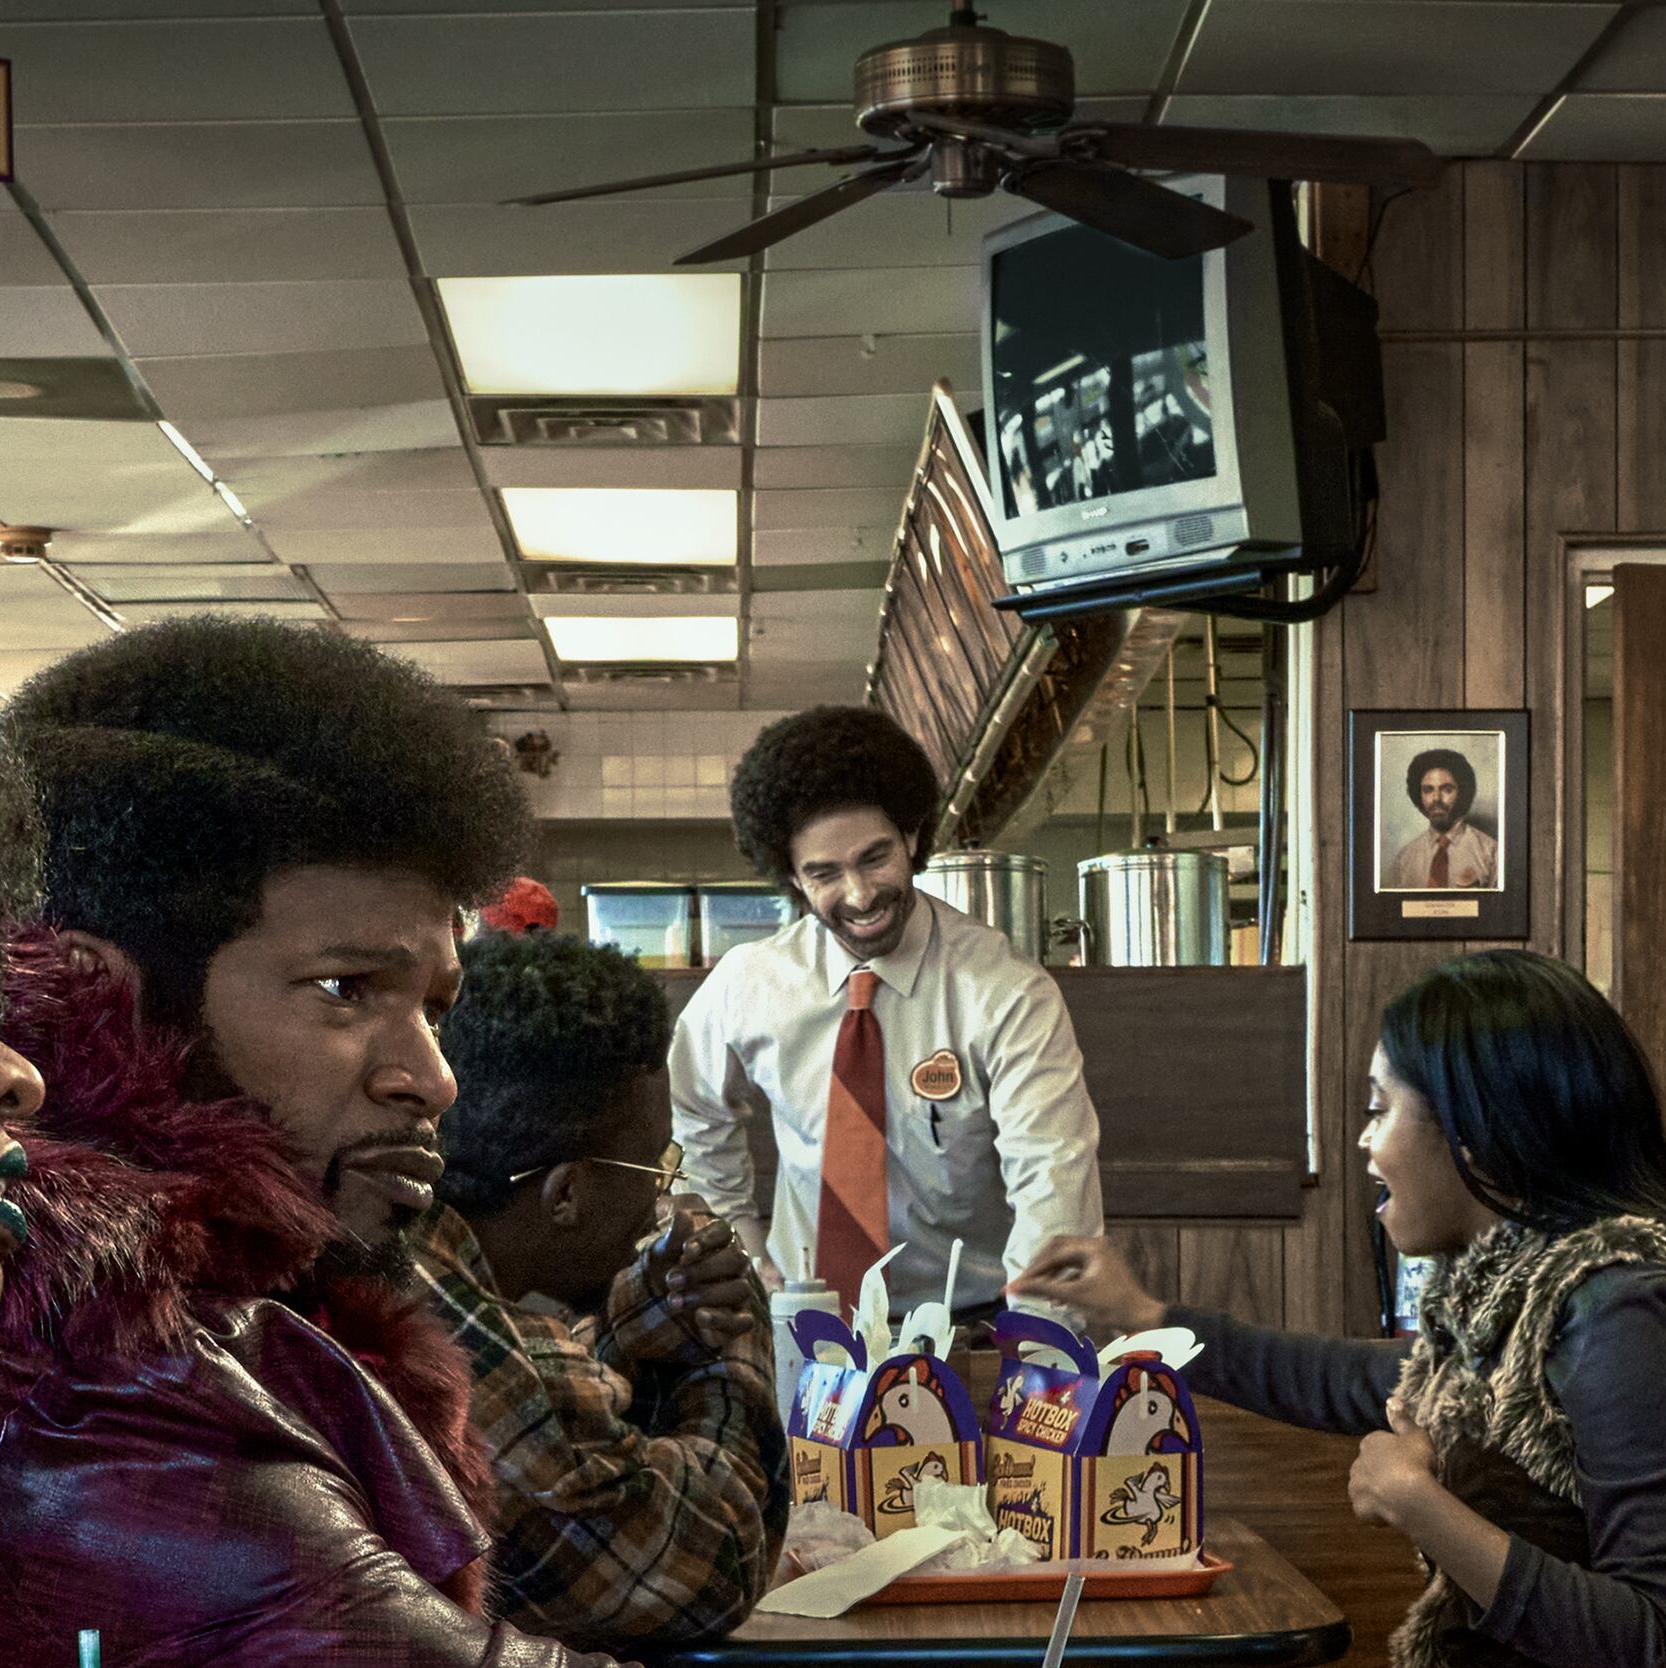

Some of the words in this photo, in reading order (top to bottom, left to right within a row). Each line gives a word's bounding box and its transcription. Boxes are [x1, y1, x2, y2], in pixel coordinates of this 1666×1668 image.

[922, 1070, 954, 1083] John
[1022, 1397, 1079, 1431] HOTBOX
[1017, 1419, 1037, 1435] SPICY
[1036, 1425, 1067, 1442] CHICKEN
